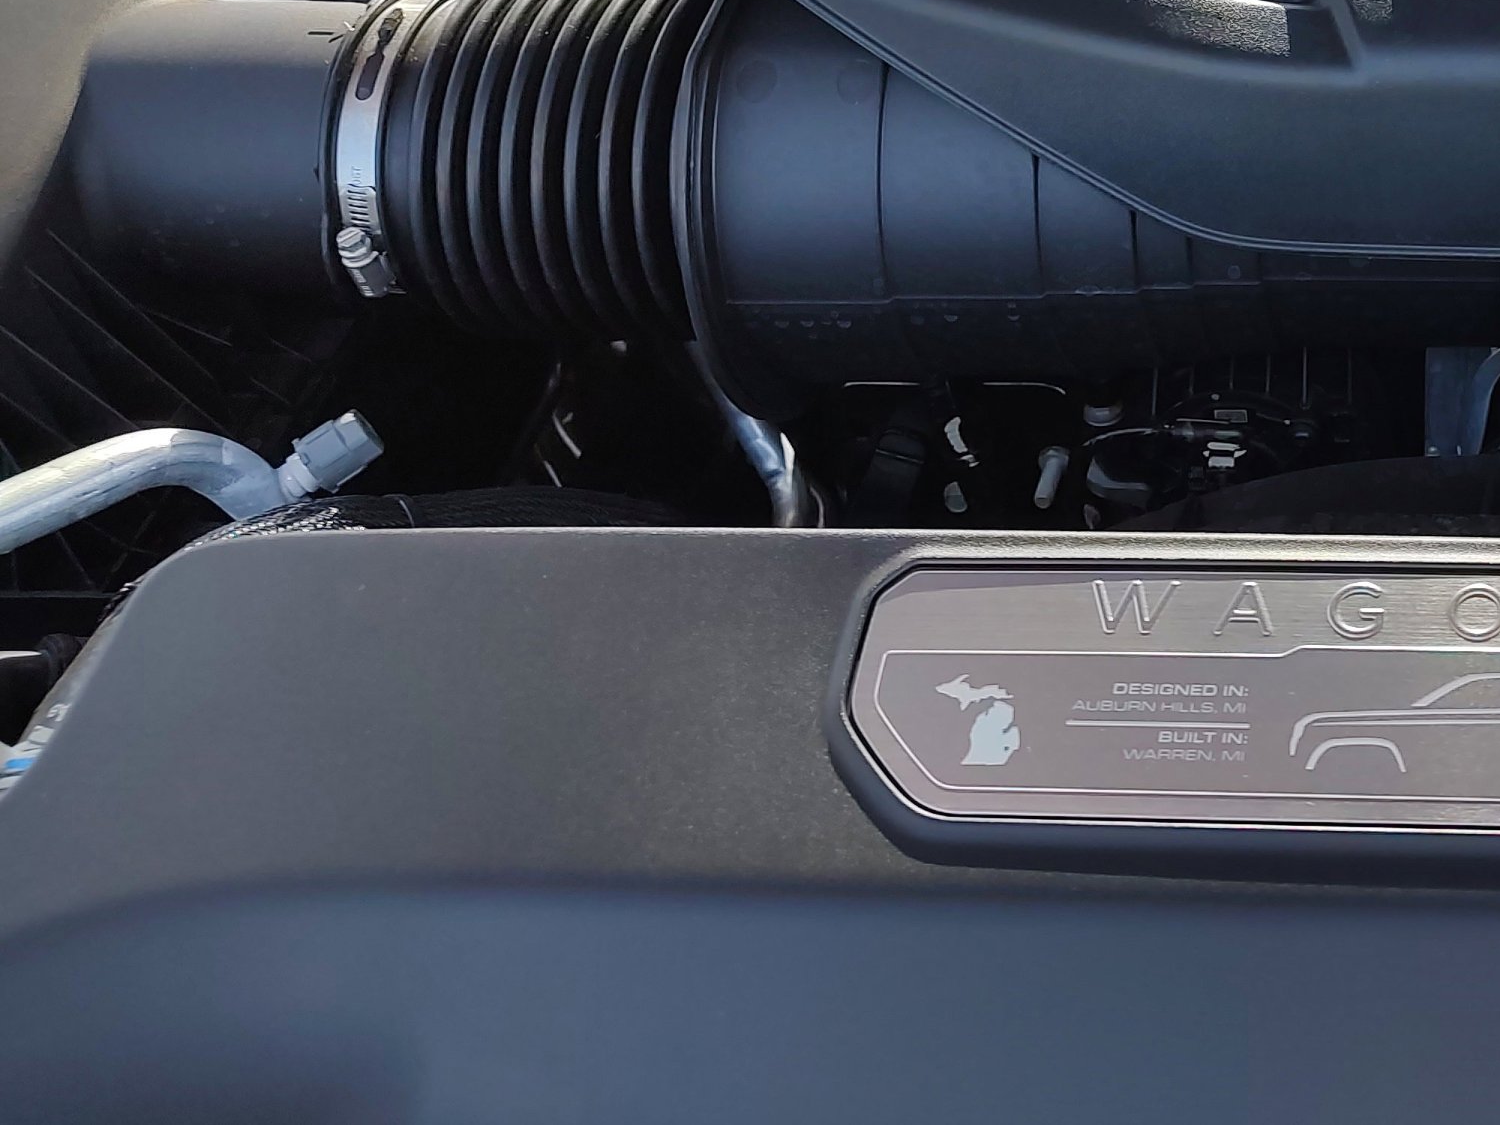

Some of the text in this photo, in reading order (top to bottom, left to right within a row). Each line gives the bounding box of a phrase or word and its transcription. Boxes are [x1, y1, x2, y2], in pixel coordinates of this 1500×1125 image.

[1113, 682, 1249, 697] DESIGNED IN:
[1072, 699, 1246, 715] AUBURN HILLS, MI
[1157, 731, 1249, 745] BUILT IN:
[1123, 748, 1246, 763] WARREN, MI
